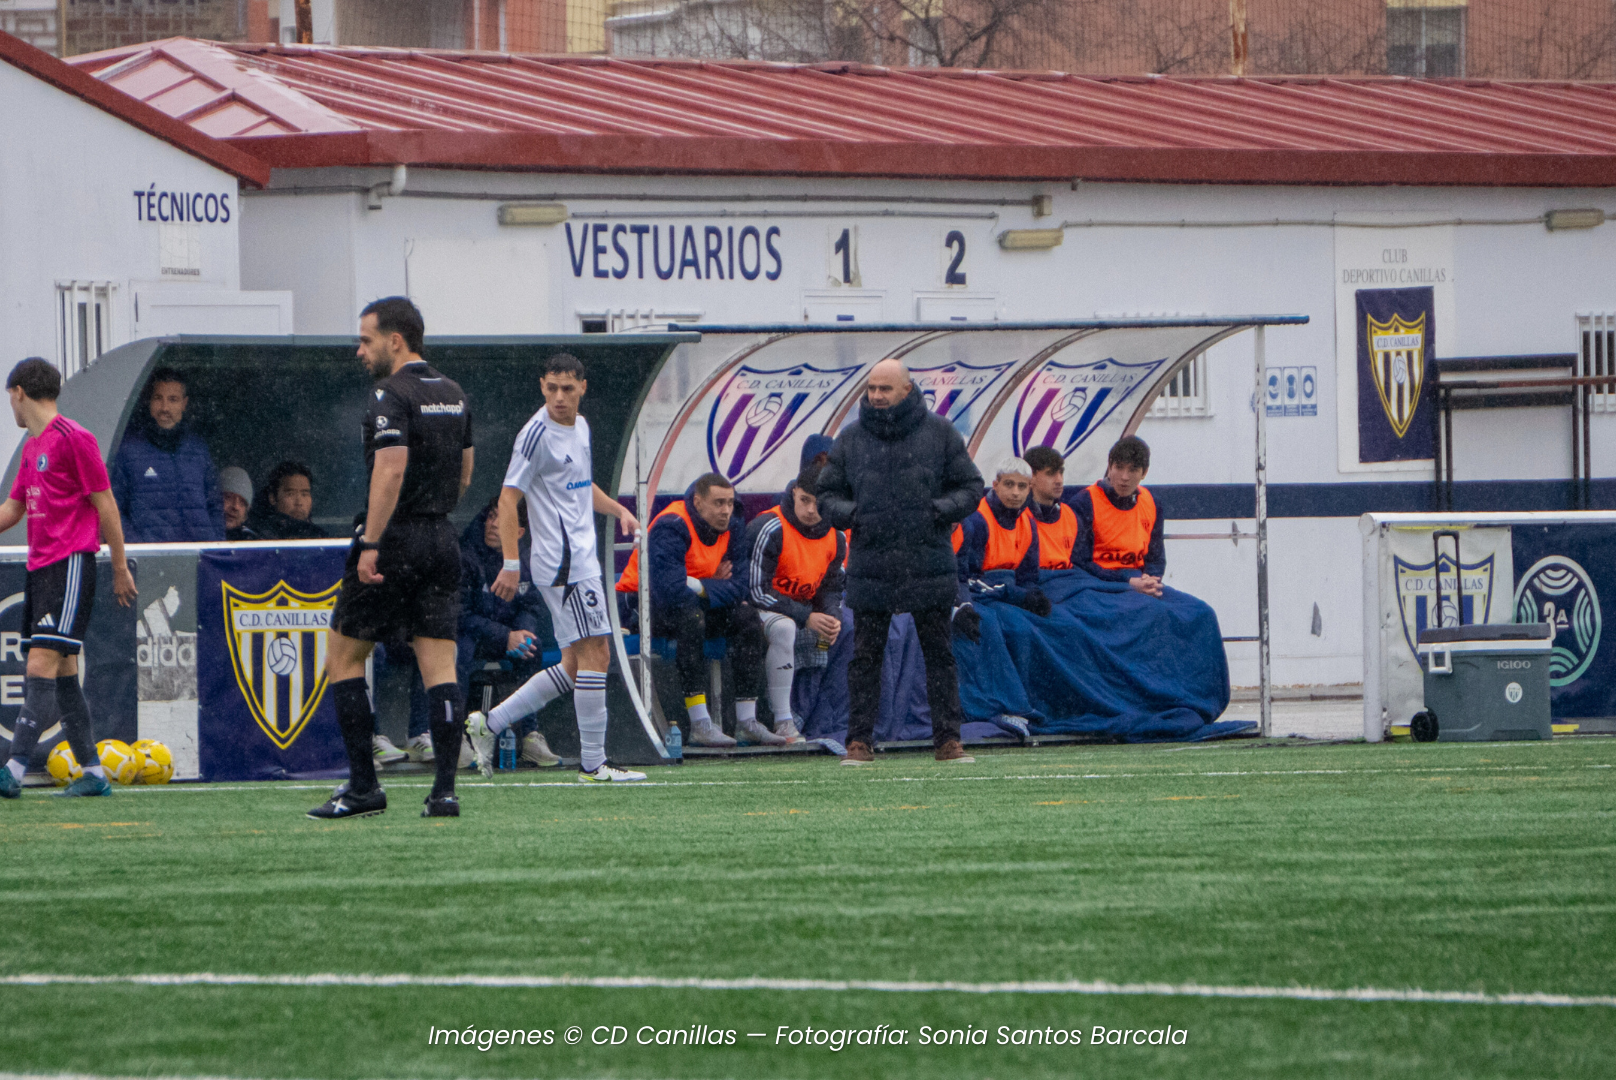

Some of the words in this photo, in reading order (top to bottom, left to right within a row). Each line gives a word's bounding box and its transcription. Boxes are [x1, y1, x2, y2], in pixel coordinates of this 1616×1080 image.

[134, 182, 231, 223] TÉCNICOS
[564, 222, 783, 281] VESTUARIOS
[834, 228, 851, 284] 1
[944, 230, 968, 285] 2
[1382, 248, 1408, 264] CLUB
[1343, 268, 1398, 284] DEPORTIVO
[1400, 267, 1447, 283] CANILLAS
[1390, 335, 1420, 348] CANILLAS
[736, 380, 761, 390] C.D.
[765, 378, 834, 389] CANILLAS
[919, 375, 988, 386] CANILLAS
[1042, 375, 1067, 384] C.D.
[1070, 372, 1138, 384] CANILLAS
[1405, 579, 1426, 591] C.D.
[1428, 577, 1484, 591] CNILAS
[585, 589, 598, 608] 3
[239, 613, 263, 627] C.D.
[265, 612, 328, 626] CANILLAS
[1497, 660, 1531, 670] IGLOO
